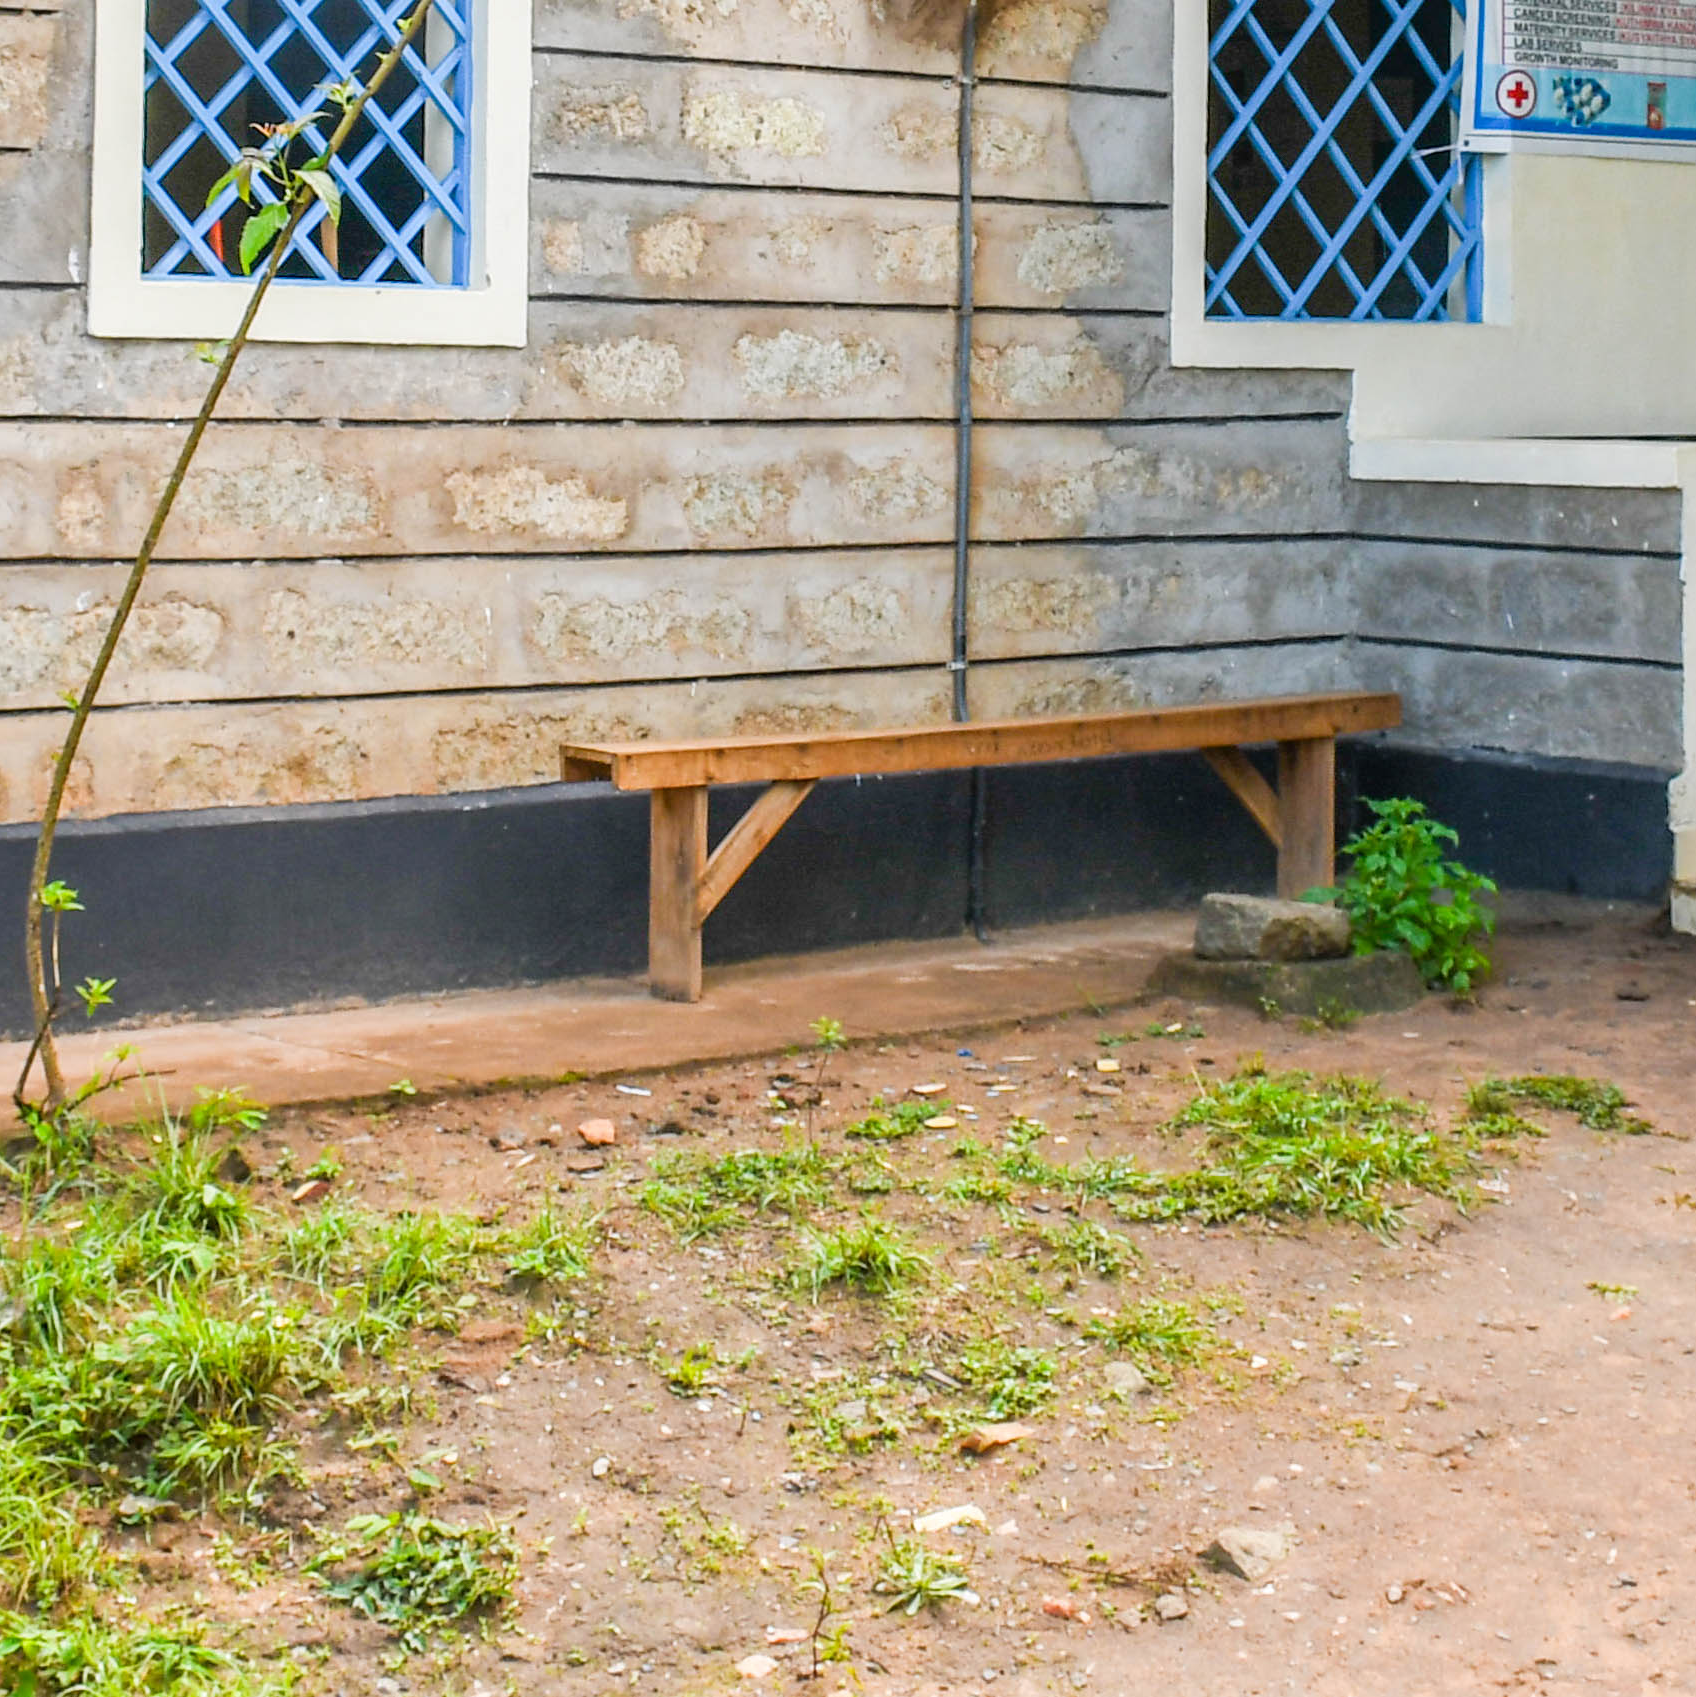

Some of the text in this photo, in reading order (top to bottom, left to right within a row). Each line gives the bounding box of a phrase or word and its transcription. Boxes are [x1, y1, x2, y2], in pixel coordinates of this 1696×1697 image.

[1514, 8, 1553, 22] CANCER
[1556, 12, 1610, 27] SCREENING
[1514, 23, 1566, 36] MATERNITY
[1569, 27, 1615, 40] SERVICES
[1514, 38, 1582, 54] LAB SERVICES
[1514, 52, 1619, 69] GROWTH MONITORING
